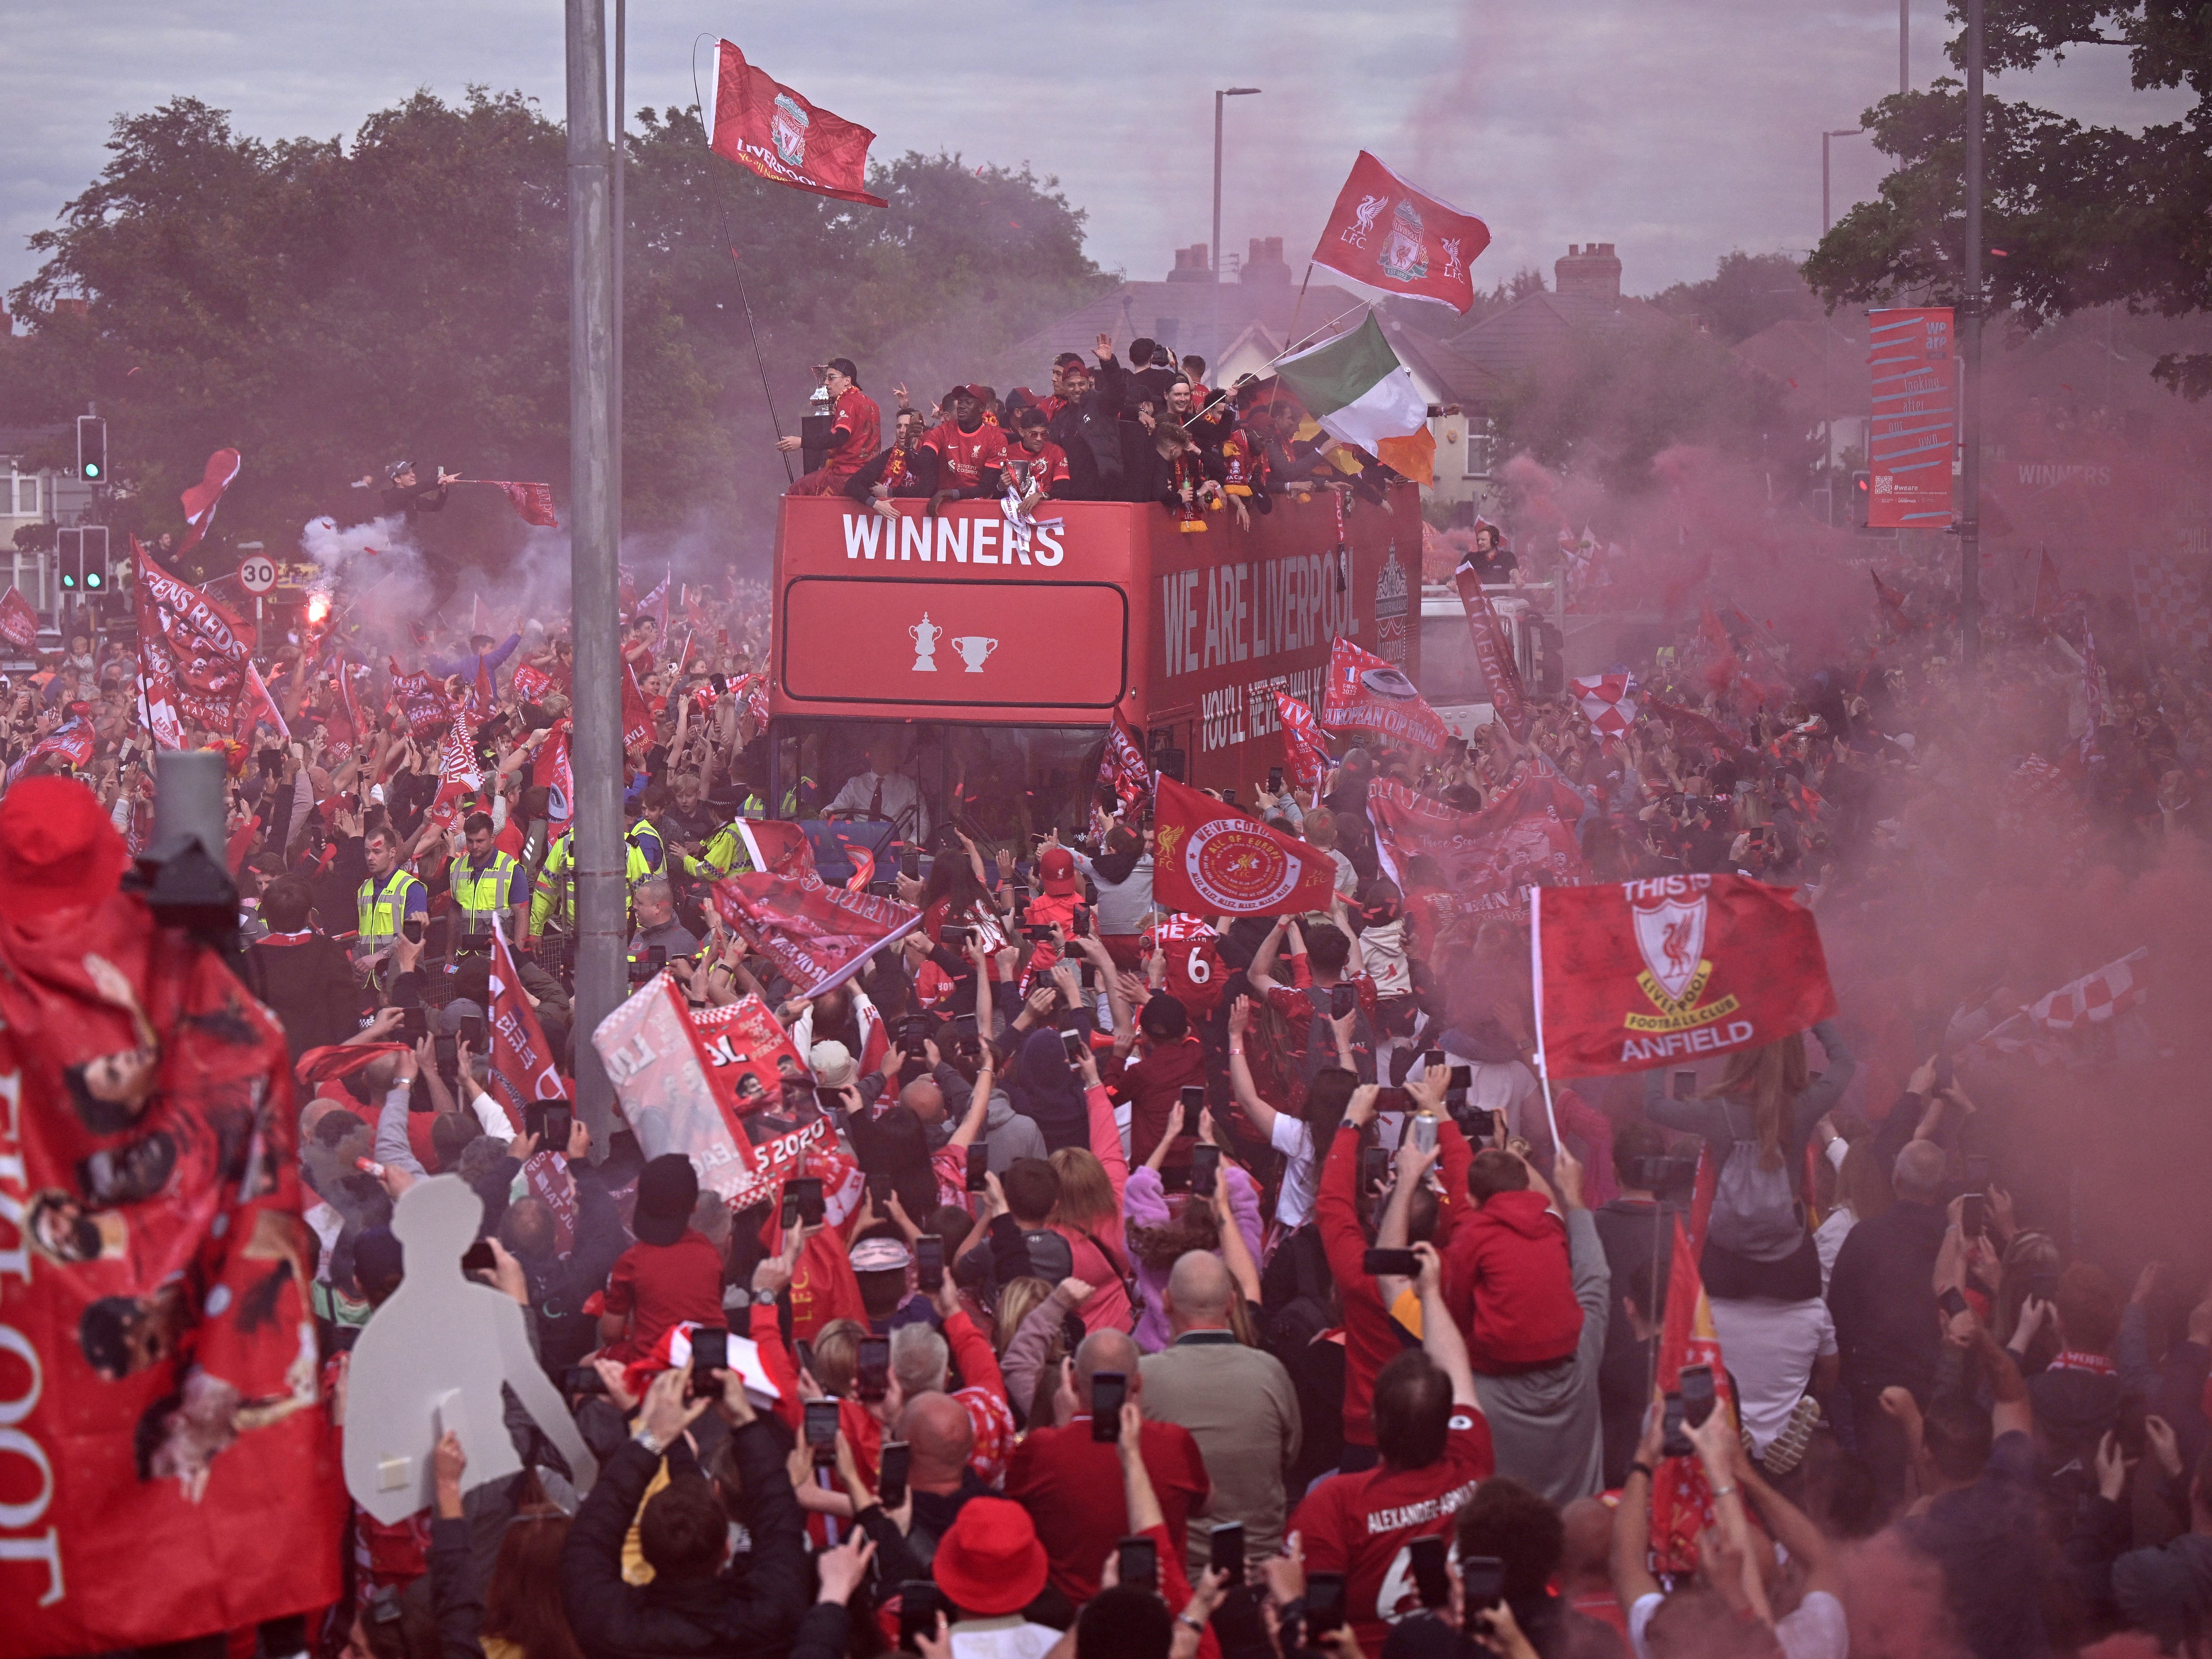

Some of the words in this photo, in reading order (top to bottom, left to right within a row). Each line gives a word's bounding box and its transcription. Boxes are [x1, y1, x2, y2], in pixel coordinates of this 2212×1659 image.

[780, 111, 801, 135] LIVERPOOL
[738, 153, 763, 173] Yo'll
[764, 168, 796, 182] Neve
[1340, 229, 1366, 250] L.F.C.
[1394, 223, 1419, 242] LIVERPOOL
[1904, 376, 1939, 393] looking
[1903, 397, 1925, 413] after
[1889, 421, 1903, 433] our
[1919, 434, 1938, 448] own
[843, 513, 1065, 567] WINNERS
[243, 565, 272, 582] 30
[1163, 569, 1198, 677] WE
[1204, 562, 1248, 669] ARE
[1253, 547, 1359, 658] LIVERPOOL
[188, 601, 248, 661] REDS
[1379, 639, 1402, 661] LIVERPOOL
[537, 678, 550, 694] FINAL
[182, 704, 206, 716] MAY
[210, 712, 228, 727] 2022
[409, 707, 442, 722] ROAD
[1202, 684, 1245, 752] YOU'LL
[1419, 704, 1432, 713] 2022
[1324, 706, 1384, 727] EUROPEAN
[1384, 710, 1407, 735] CUP
[1406, 719, 1437, 749] FINAL
[1195, 820, 1230, 842] WE'VE
[1208, 840, 1226, 853] ALL
[1248, 838, 1282, 859] EUROPE
[1276, 884, 1292, 899] ALLEZ
[1621, 875, 1686, 902] THIS
[1188, 947, 1210, 984] 6
[1629, 1014, 1696, 1029] FOOTBALL
[1699, 998, 1735, 1020] CLUB
[1621, 1020, 1754, 1063] ANFIELD
[772, 1118, 826, 1164] 2020
[1367, 1480, 1480, 1535] ALEXANDER-ARNOL
